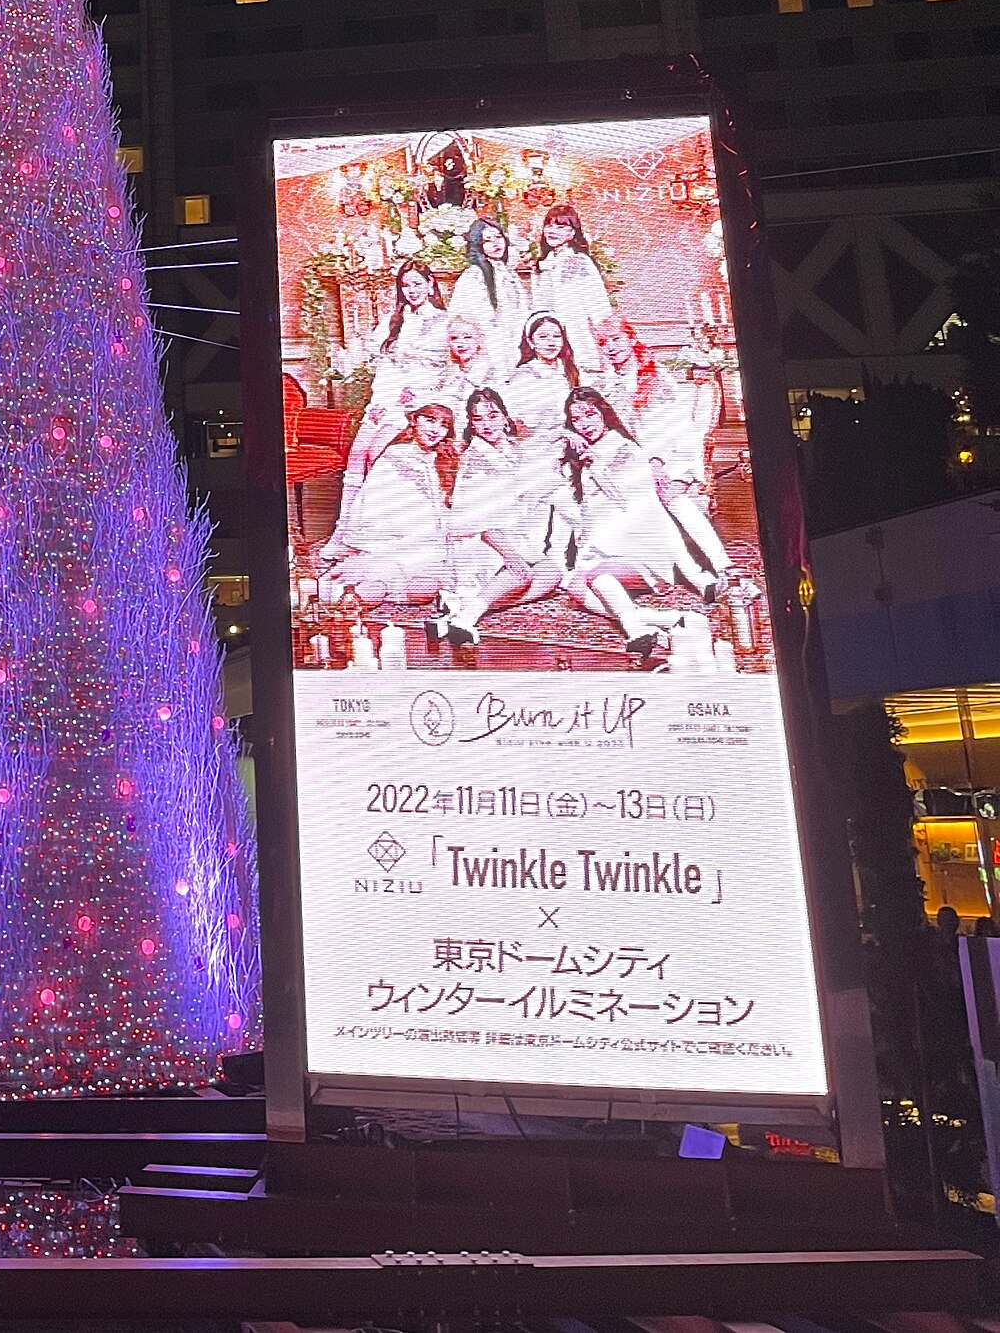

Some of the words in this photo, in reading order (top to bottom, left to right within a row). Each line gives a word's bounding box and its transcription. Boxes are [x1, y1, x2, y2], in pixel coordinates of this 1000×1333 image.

[331, 698, 371, 714] TOKYO
[457, 691, 566, 743] Burn
[565, 700, 596, 734] it
[686, 702, 733, 718] OSAKA
[432, 937, 672, 981] 東京ドームシティ
[367, 978, 756, 1027] ウィンターイルミネーション
